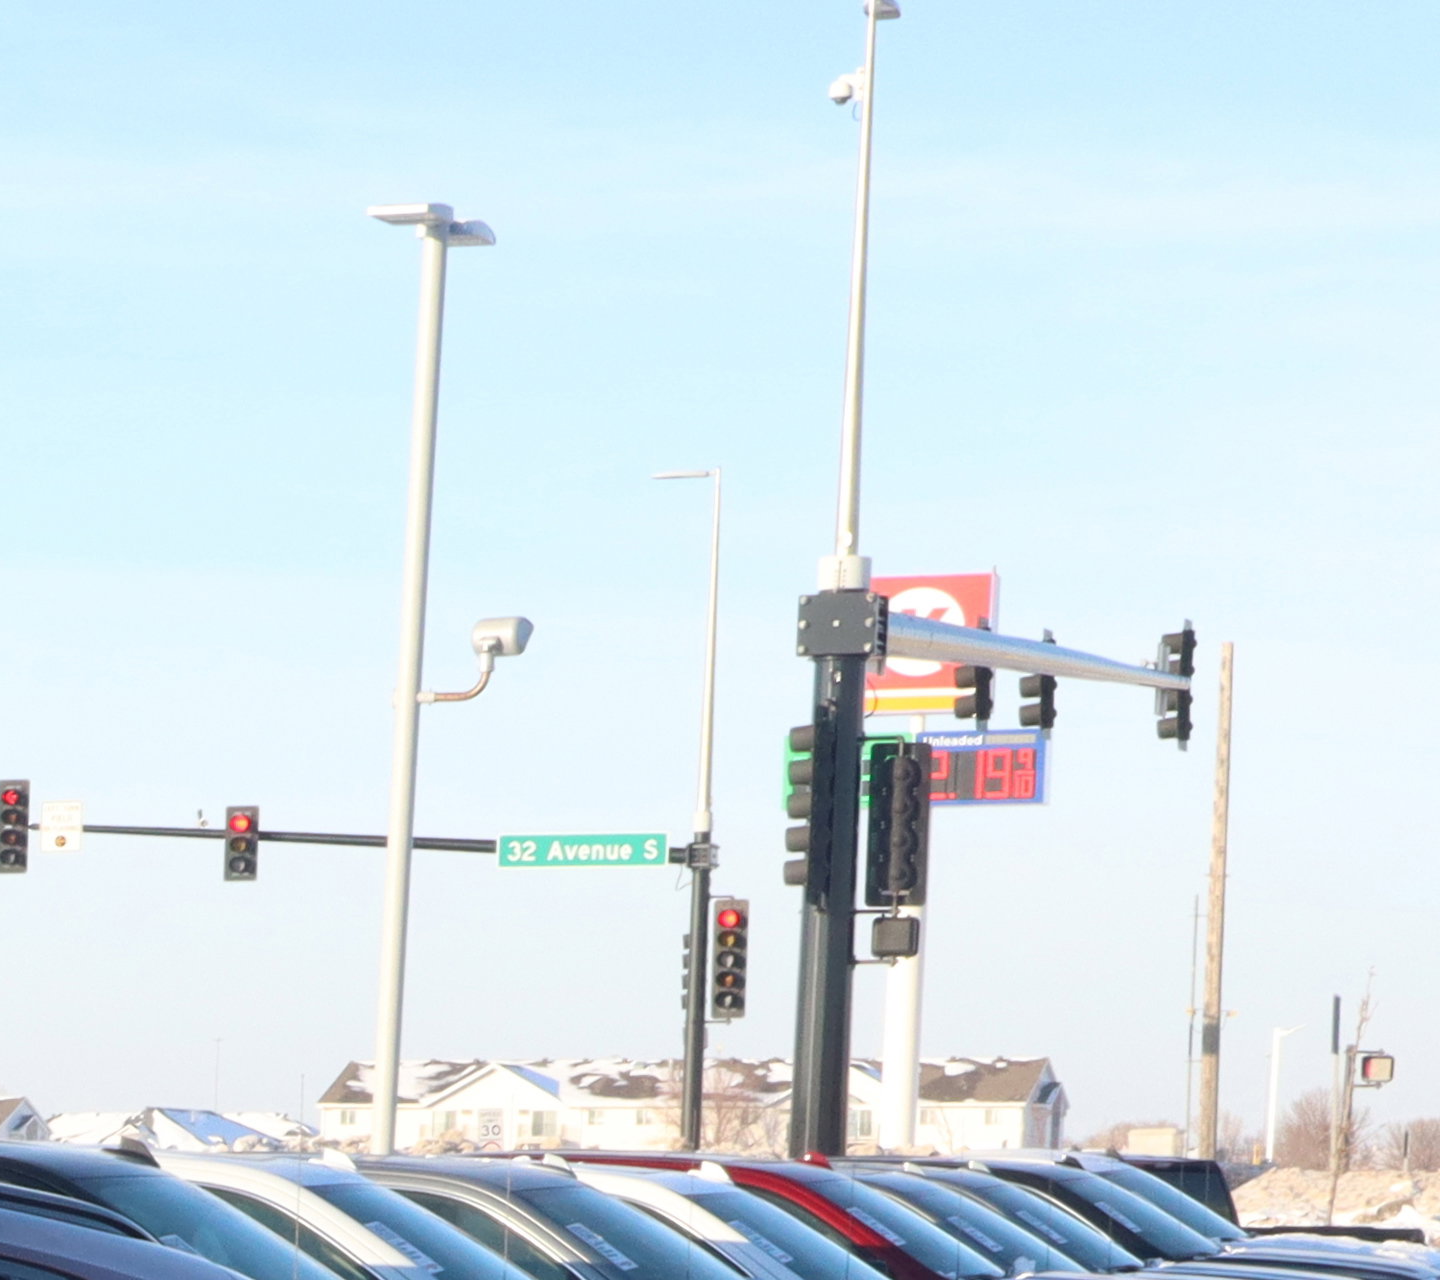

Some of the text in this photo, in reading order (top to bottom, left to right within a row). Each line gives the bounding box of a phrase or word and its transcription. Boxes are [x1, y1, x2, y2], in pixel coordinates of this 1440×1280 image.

[923, 735, 984, 748] Unleaded
[507, 839, 659, 862] 32 Avenue S
[481, 1124, 502, 1137] 30
